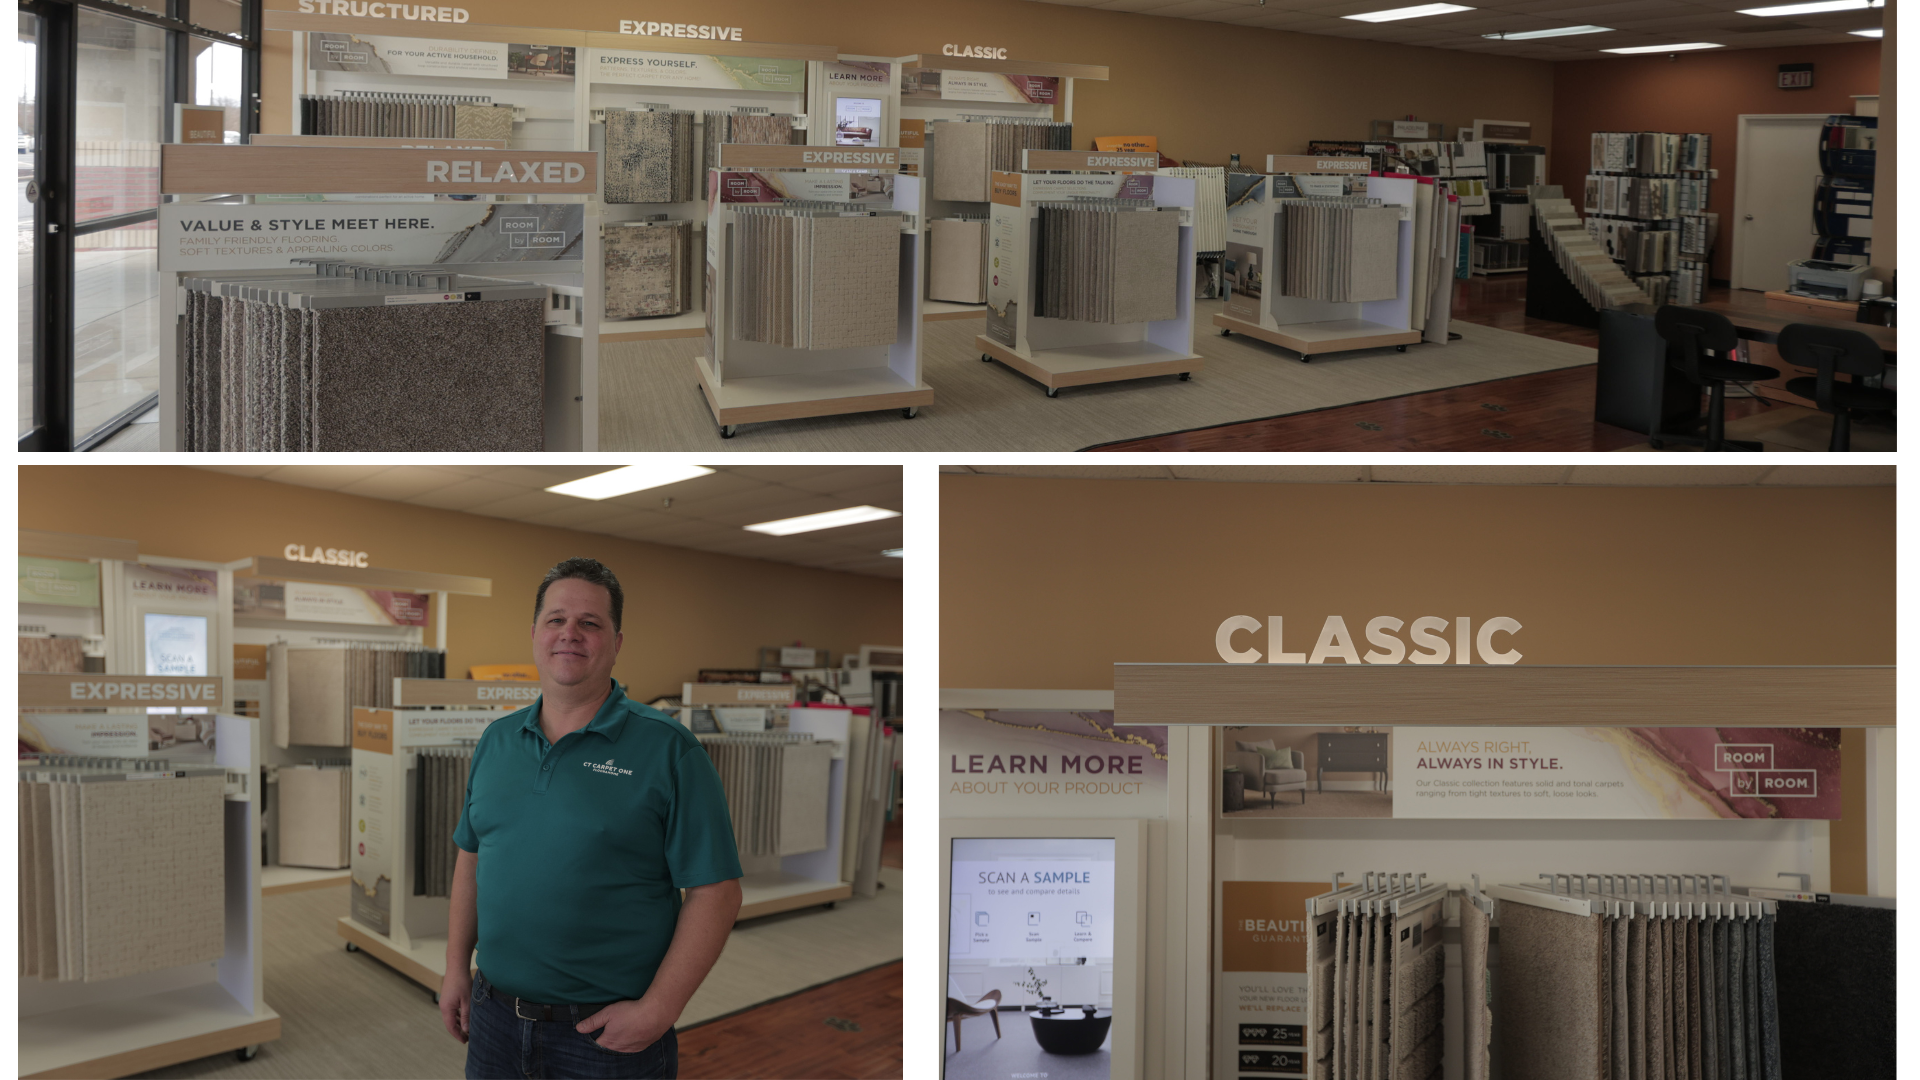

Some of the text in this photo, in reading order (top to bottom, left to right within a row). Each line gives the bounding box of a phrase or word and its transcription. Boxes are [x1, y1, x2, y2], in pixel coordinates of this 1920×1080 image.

[298, 0, 470, 23] STRUCTURED
[619, 19, 743, 41] EXPRESSIVE
[453, 53, 499, 61] HOUSEHOLD.
[942, 43, 1008, 60] CLASSIC
[600, 56, 698, 68] EXPRESS YOURSELF.
[1781, 72, 1811, 86] EXIT
[189, 130, 216, 139] BEAUTIFUL
[802, 151, 895, 164] EXPRESSIVE
[1087, 156, 1155, 168] EXPRESSIVE
[427, 160, 585, 183] RELAXED
[1316, 160, 1368, 170] EXPRESSIVE
[180, 218, 435, 232] VALUE & STYLE MEET HERE.
[180, 235, 340, 245] FAMILY FRIENDLY FLOORING.
[514, 236, 524, 245] by
[179, 244, 395, 256] SOFT TEXTURES & APPEALING COLORS.
[284, 543, 369, 568] CLASSIC
[133, 580, 209, 595] LEARN MORE
[1215, 615, 1523, 664] CLASSIC
[157, 663, 195, 674] SAMPLE
[70, 682, 216, 700] EXPRESSIVE
[477, 686, 542, 700] EXPRESSI
[736, 688, 792, 701] EXPRESSIVE
[1416, 741, 1532, 755] ALWAYS RIGHT,
[951, 754, 1143, 774] LEARN MORE
[1416, 757, 1564, 770] ALWAYS IN STYLE.
[1723, 752, 1765, 763] ROOM
[592, 763, 618, 772] CARPET
[618, 768, 633, 776] ONE
[950, 781, 1143, 794] ABOUT YOUR PRODUCT
[1416, 779, 1624, 789] Our Classic collection features solid and tonal carpets
[1738, 778, 1808, 789] by ROOM
[1416, 789, 1599, 798] ranging from tight textures to soft, loose looks.
[978, 871, 1090, 884] SCAN A SAMPLE
[1025, 889, 1055, 897] compare
[1245, 919, 1307, 932] BEAUTI
[1252, 934, 1307, 943] GUARANT
[1238, 985, 1307, 994] YOU'LL LOVE TH
[1238, 1004, 1301, 1013] WE'LL REPLACE
